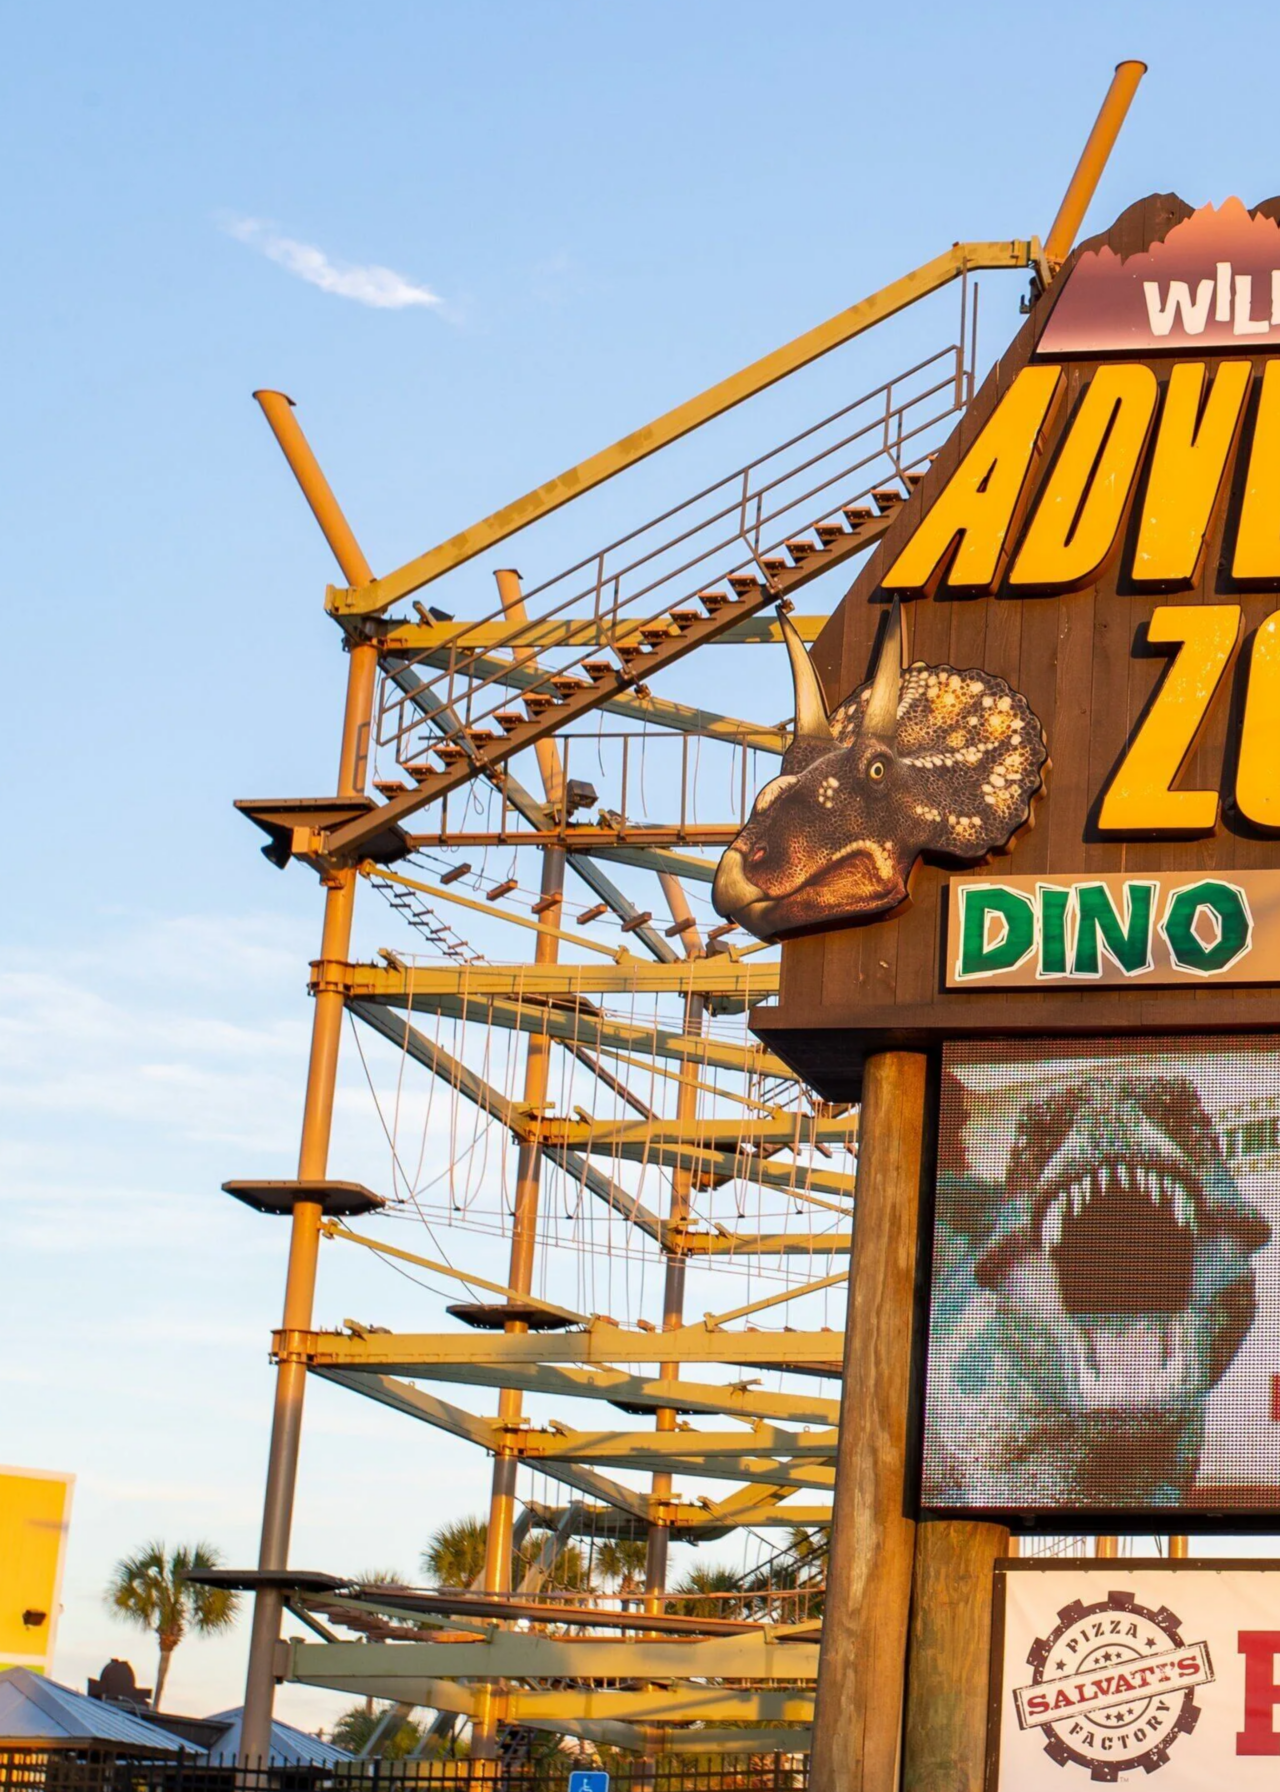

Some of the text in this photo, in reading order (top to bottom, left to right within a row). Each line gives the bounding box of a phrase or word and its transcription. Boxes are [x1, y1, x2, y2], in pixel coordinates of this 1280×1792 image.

[955, 880, 1253, 980] DINO
[1065, 1619, 1139, 1654] PIZZA
[1026, 1654, 1201, 1717] SALVATI'S
[1068, 1699, 1171, 1751] FACTORY
